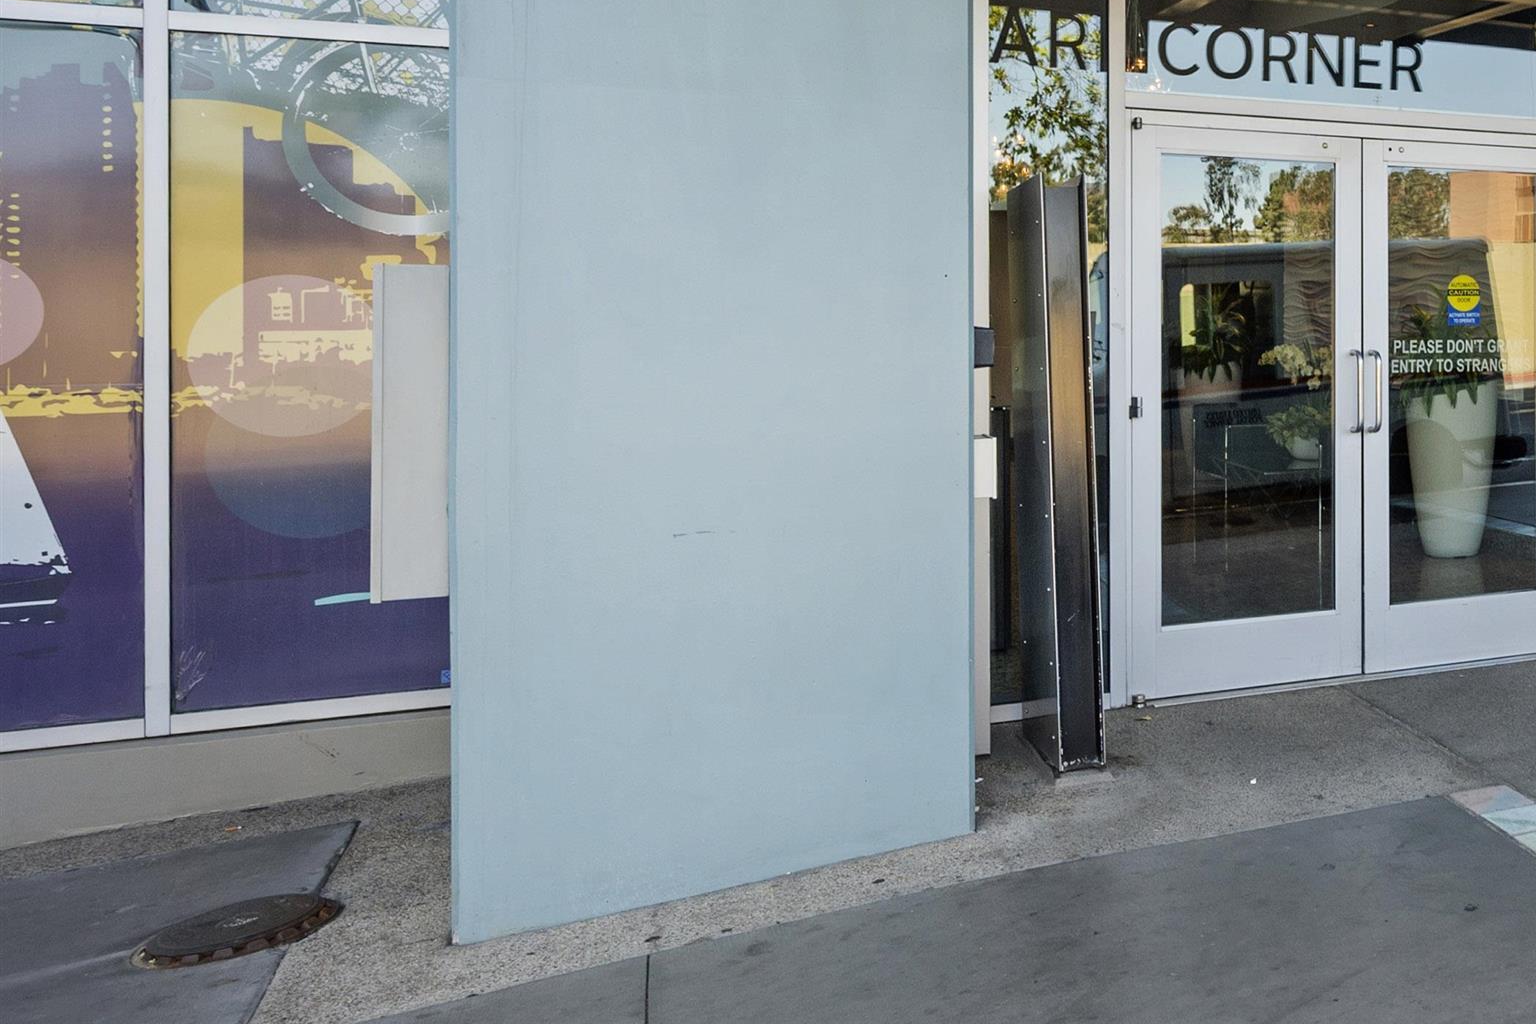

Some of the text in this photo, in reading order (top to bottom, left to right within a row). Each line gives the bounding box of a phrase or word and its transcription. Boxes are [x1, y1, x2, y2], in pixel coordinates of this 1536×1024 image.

[1157, 21, 1423, 93] CORNER
[1393, 339, 1529, 354] PLEASE DON'T GRT
[1391, 358, 1531, 373] ENTRY TO STRANGS
